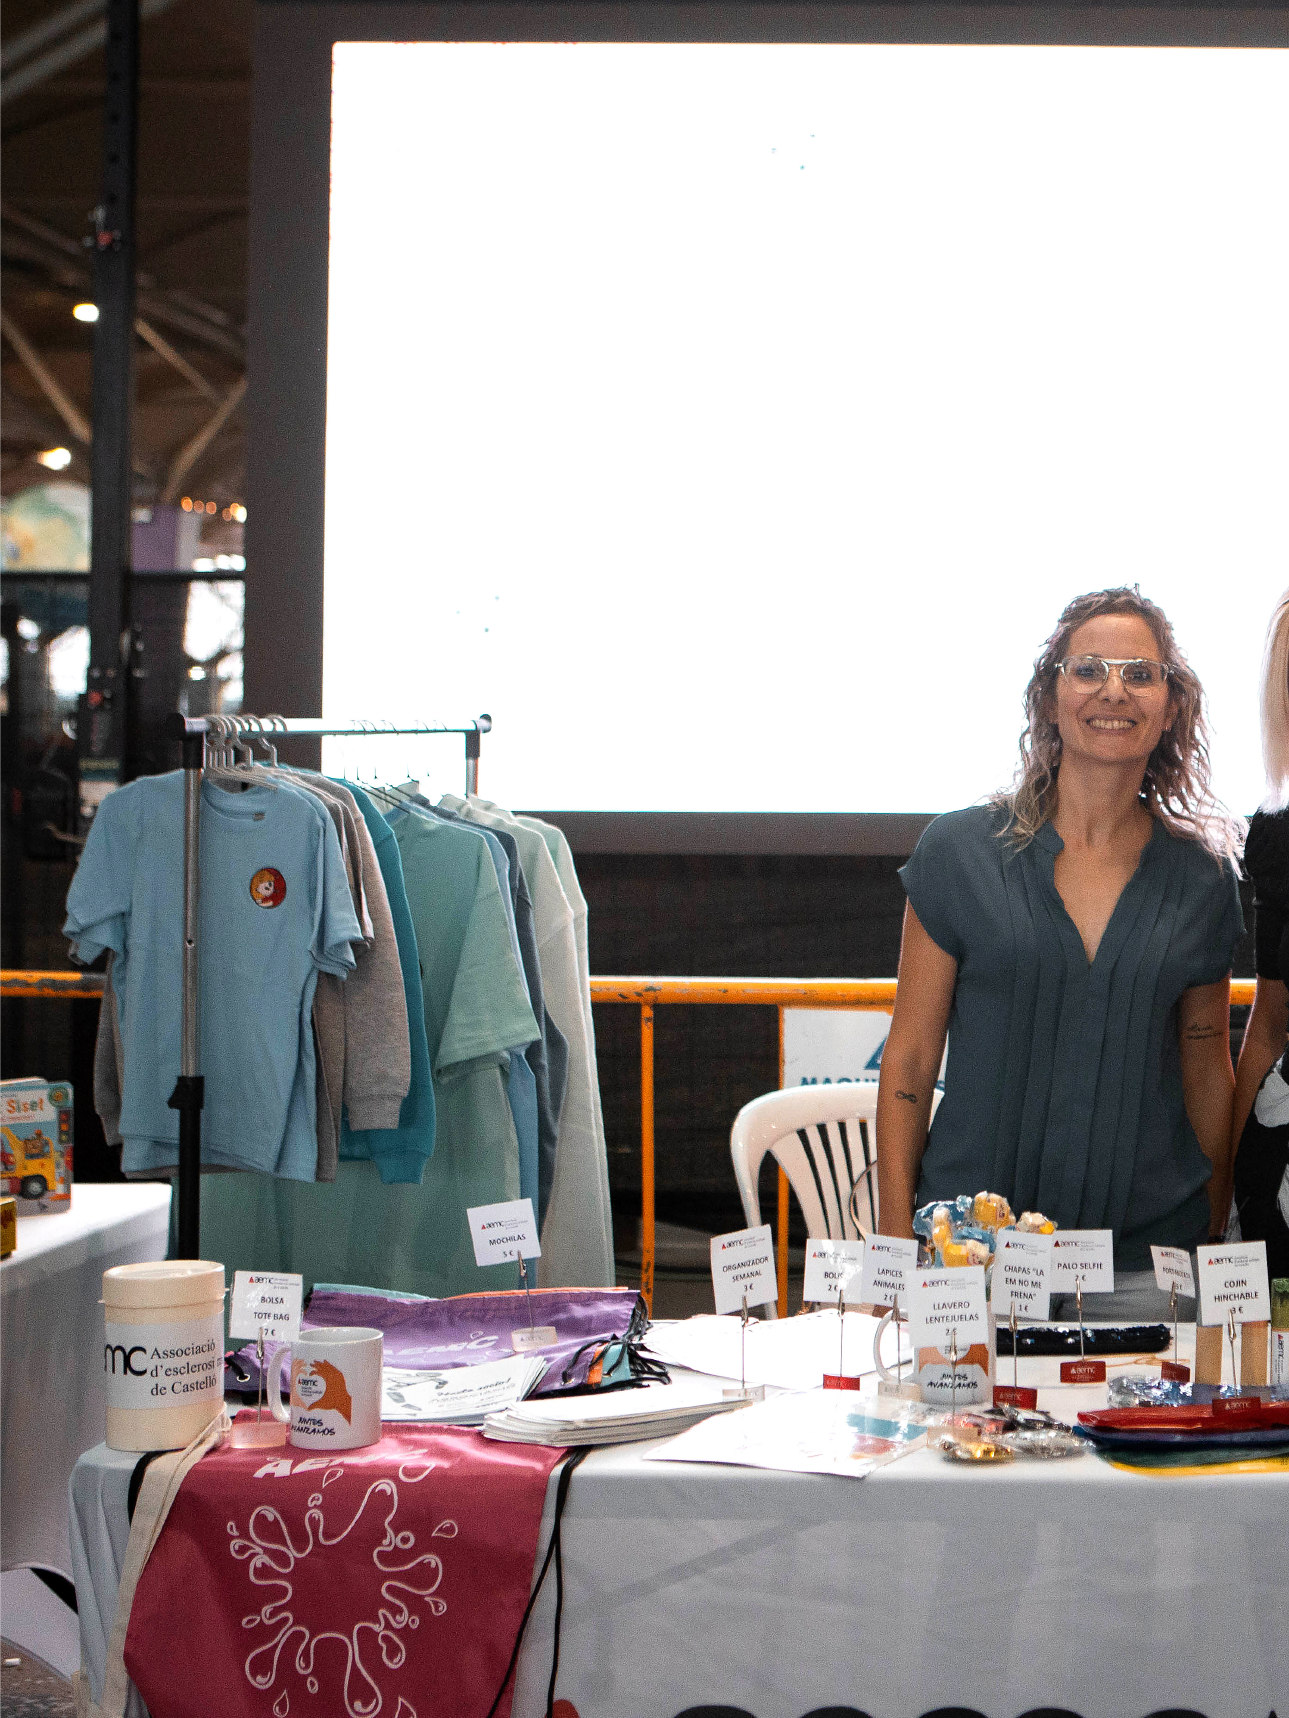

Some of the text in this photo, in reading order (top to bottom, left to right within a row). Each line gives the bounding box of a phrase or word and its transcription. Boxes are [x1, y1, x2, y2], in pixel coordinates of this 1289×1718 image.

[488, 1233, 526, 1247] MOCHILAS
[722, 1256, 768, 1272] ORGANIZADOR
[1057, 1261, 1104, 1271] PALO SELFIE
[731, 1270, 763, 1283] SEMANAL
[877, 1267, 903, 1278] LAPICES
[1004, 1265, 1032, 1276] CHAPAS
[872, 1280, 905, 1292] ANIMALES
[1005, 1277, 1043, 1289] EM NO ME
[1223, 1280, 1247, 1289] COJIN
[260, 1295, 285, 1305] BOLSA
[1214, 1291, 1259, 1303] HINCHABLE
[933, 1300, 971, 1311] LLAVERO
[273, 1312, 290, 1322] BAG
[925, 1313, 980, 1325] LENTEJUELAS
[150, 1339, 216, 1361] Associació
[150, 1374, 218, 1397] de Castelló
[926, 1380, 978, 1390] AVANZAMOS
